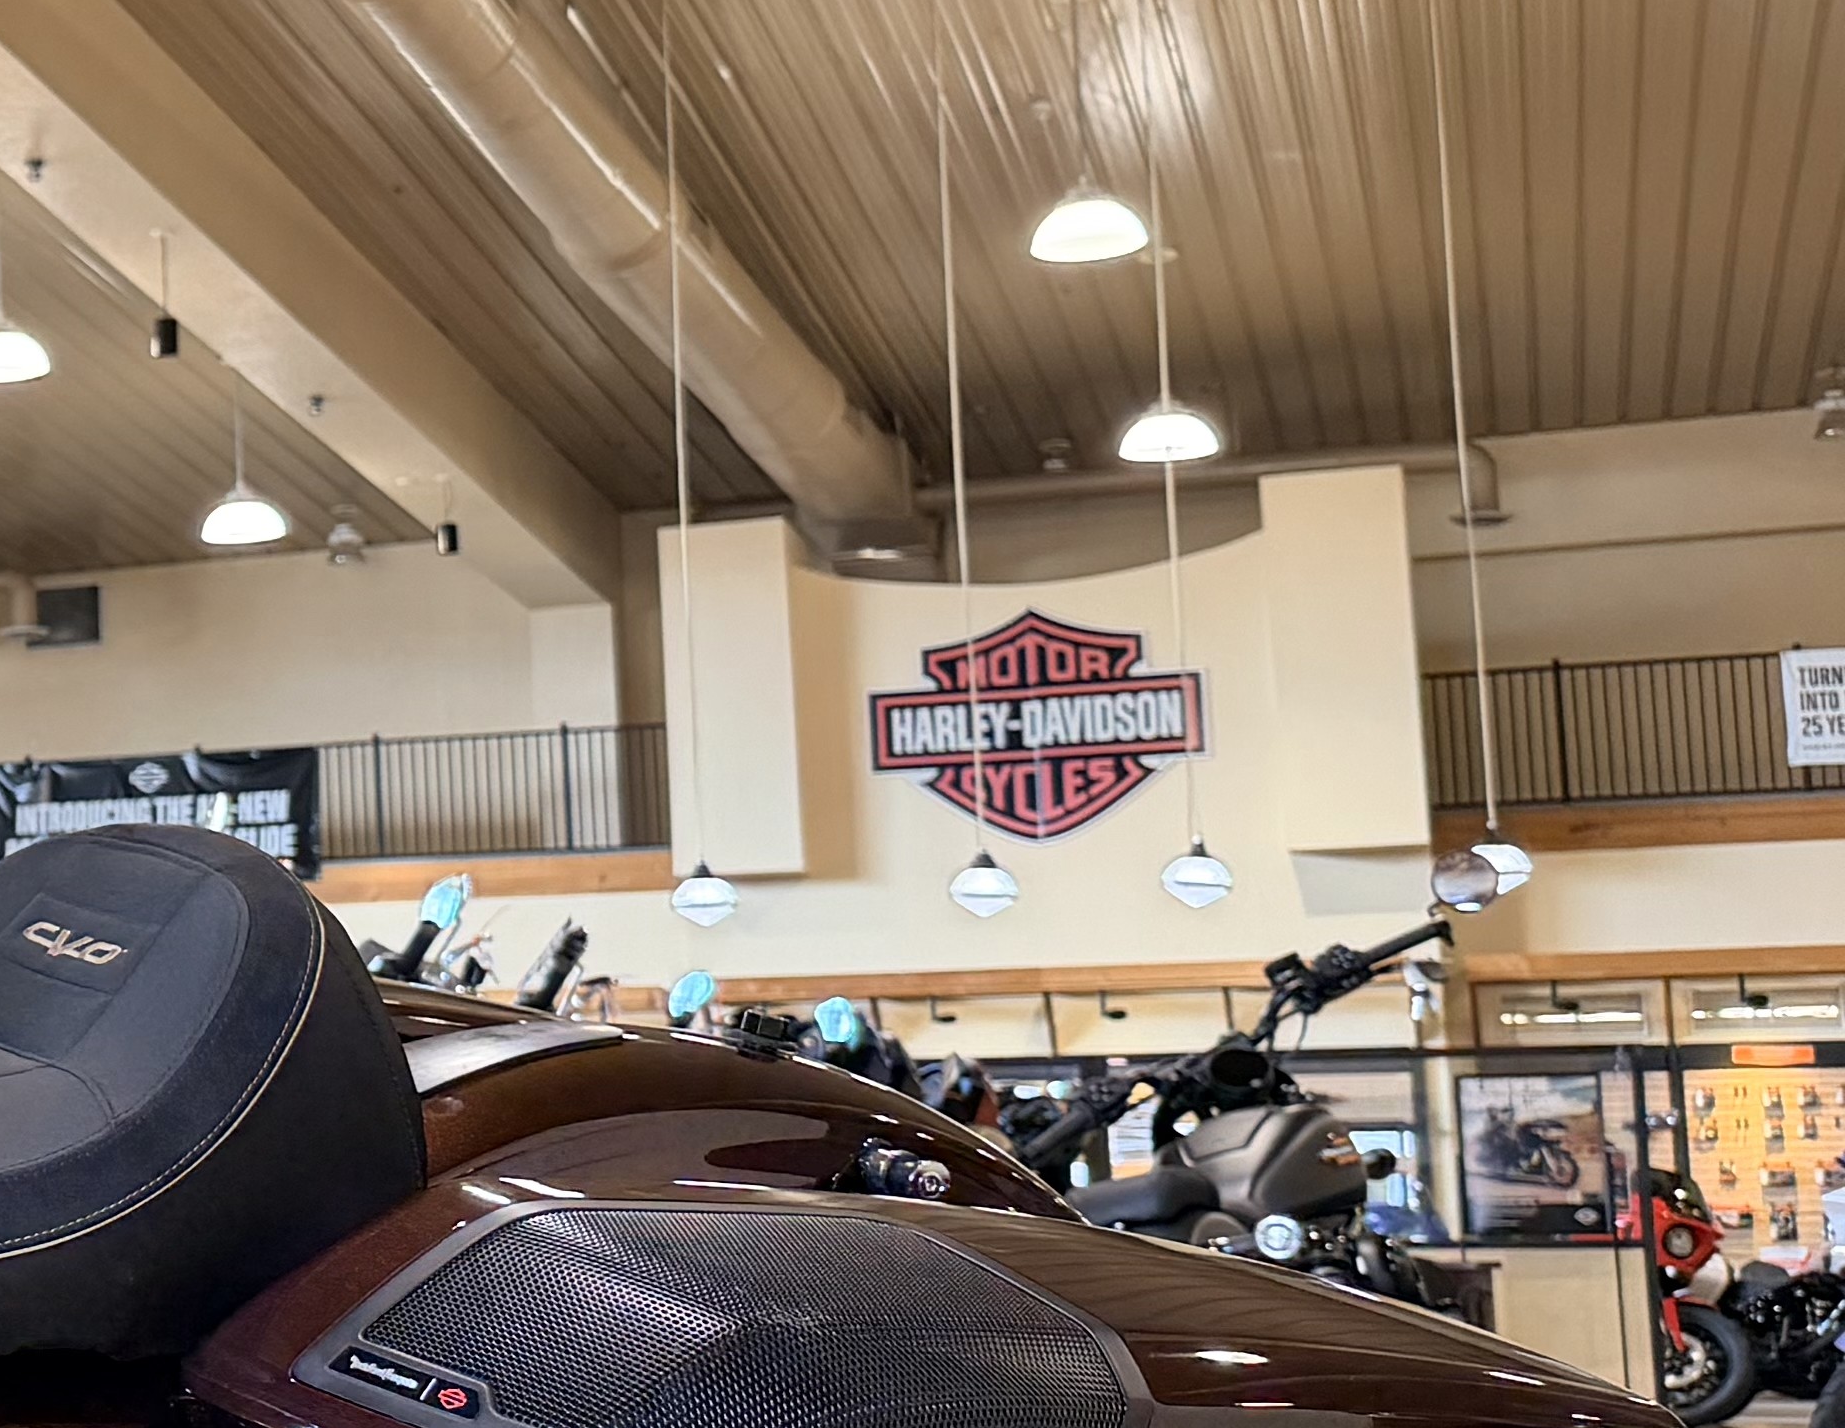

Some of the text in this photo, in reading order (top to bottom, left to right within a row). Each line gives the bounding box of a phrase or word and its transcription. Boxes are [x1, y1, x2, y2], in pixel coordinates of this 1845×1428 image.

[955, 632, 1112, 691] MOTOR
[890, 689, 1184, 756] HARLEY-DAVIDSON
[1799, 689, 1840, 712] INTO
[1801, 715, 1823, 737] 25
[152, 793, 195, 824] THE
[960, 758, 1117, 823] CYCLES
[22, 921, 124, 965] CVO
